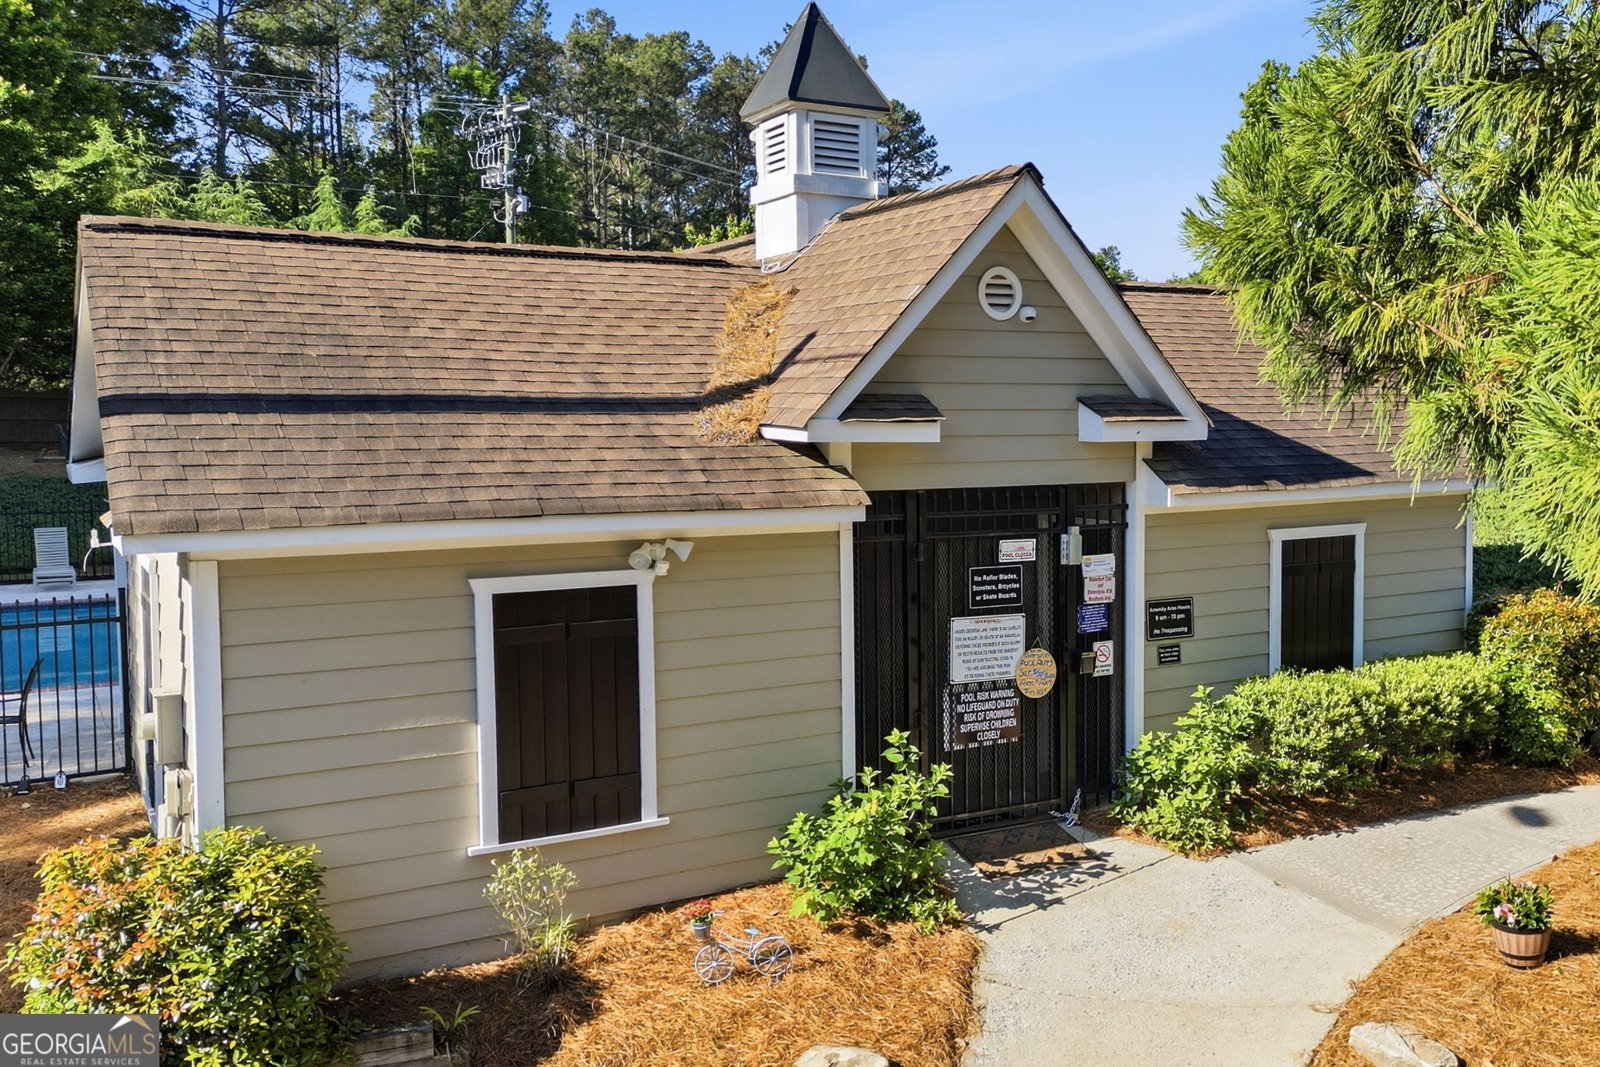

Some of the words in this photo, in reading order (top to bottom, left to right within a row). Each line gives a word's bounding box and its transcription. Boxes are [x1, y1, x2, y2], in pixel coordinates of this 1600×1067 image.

[960, 693, 976, 702] POOL
[977, 691, 990, 701] RISK
[990, 689, 1015, 699] WARNING
[956, 704, 965, 713] NO
[966, 700, 996, 712] LIFEGUARD
[997, 700, 1005, 708] ON
[1006, 698, 1020, 707] DUTY
[964, 713, 977, 722] RISK
[977, 712, 985, 721] OF
[986, 708, 1015, 720] DROWNING
[960, 721, 990, 733] SUPERVISE
[991, 718, 1017, 729] CHILDREN
[977, 730, 1001, 741] CLOSELY
